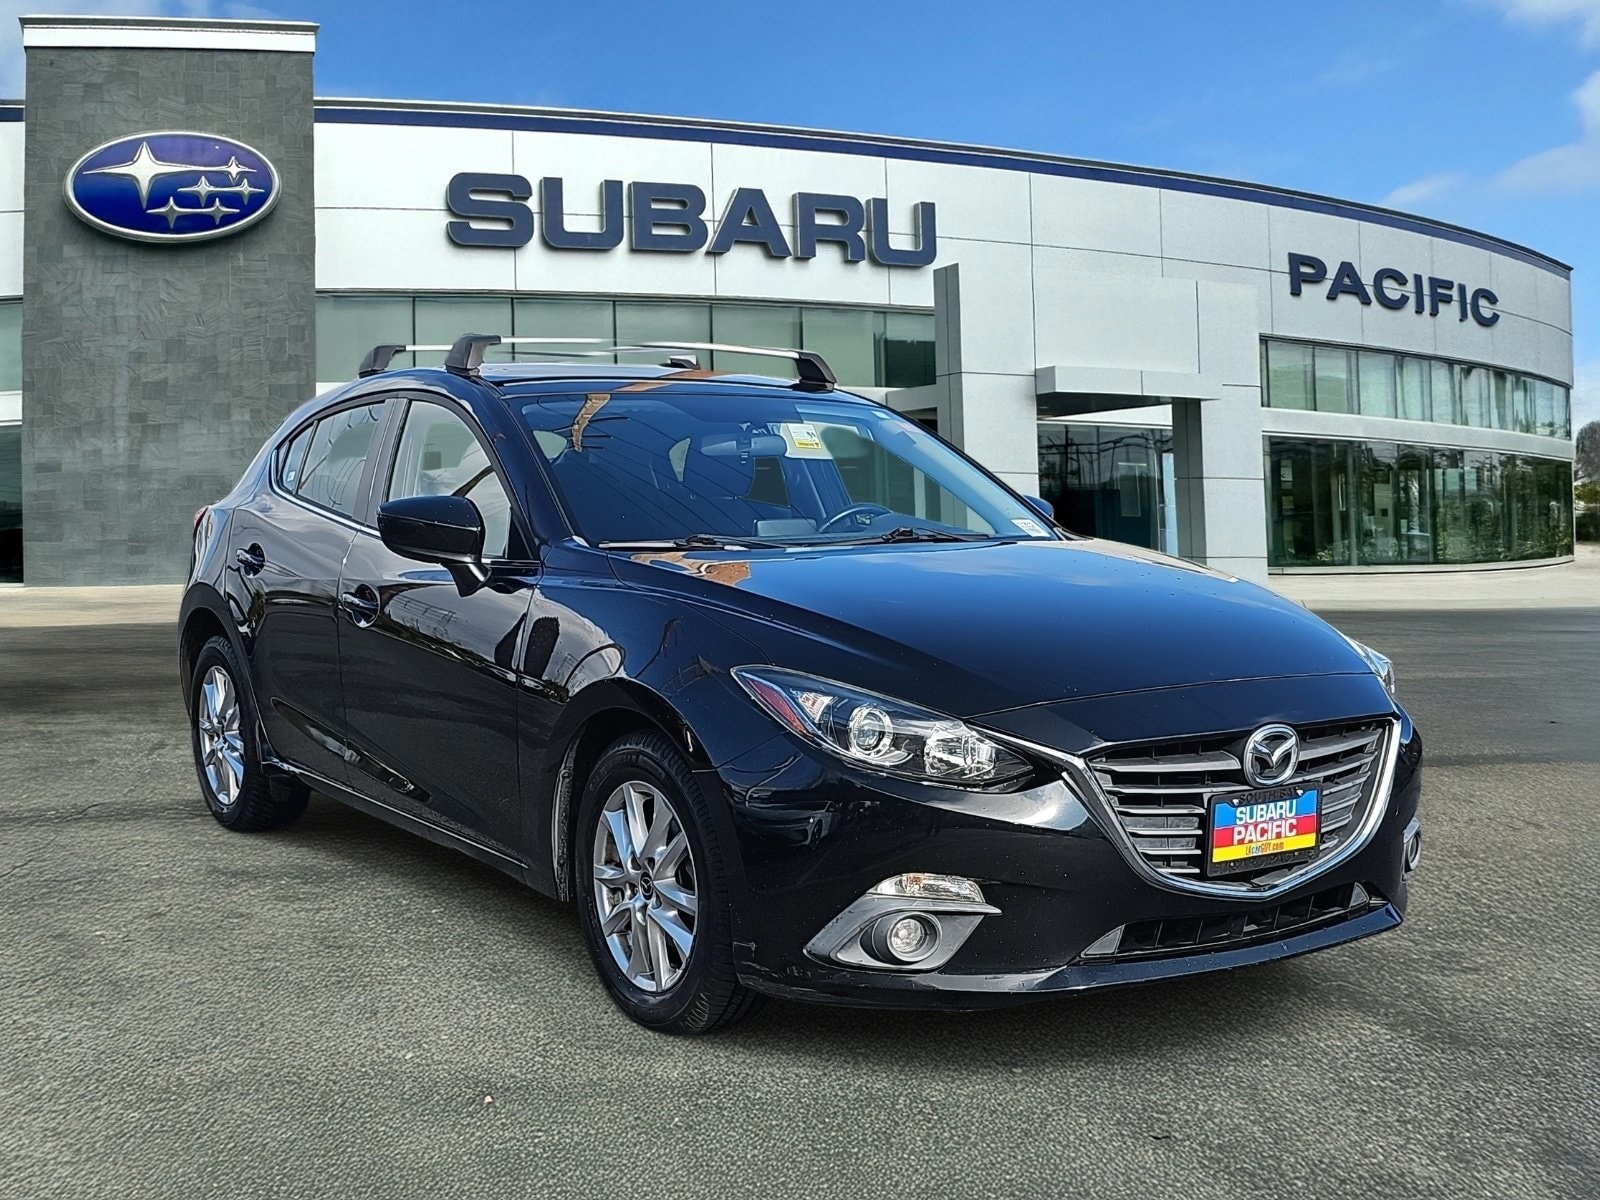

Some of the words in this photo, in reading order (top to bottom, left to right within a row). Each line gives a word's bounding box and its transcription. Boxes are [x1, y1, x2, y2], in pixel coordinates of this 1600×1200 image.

[447, 172, 937, 267] SUBARU
[1288, 252, 1500, 327] PACIFIC
[1239, 790, 1275, 804] SOUTH
[1235, 798, 1297, 825] SUBARU
[1233, 819, 1297, 845] PACIFIC
